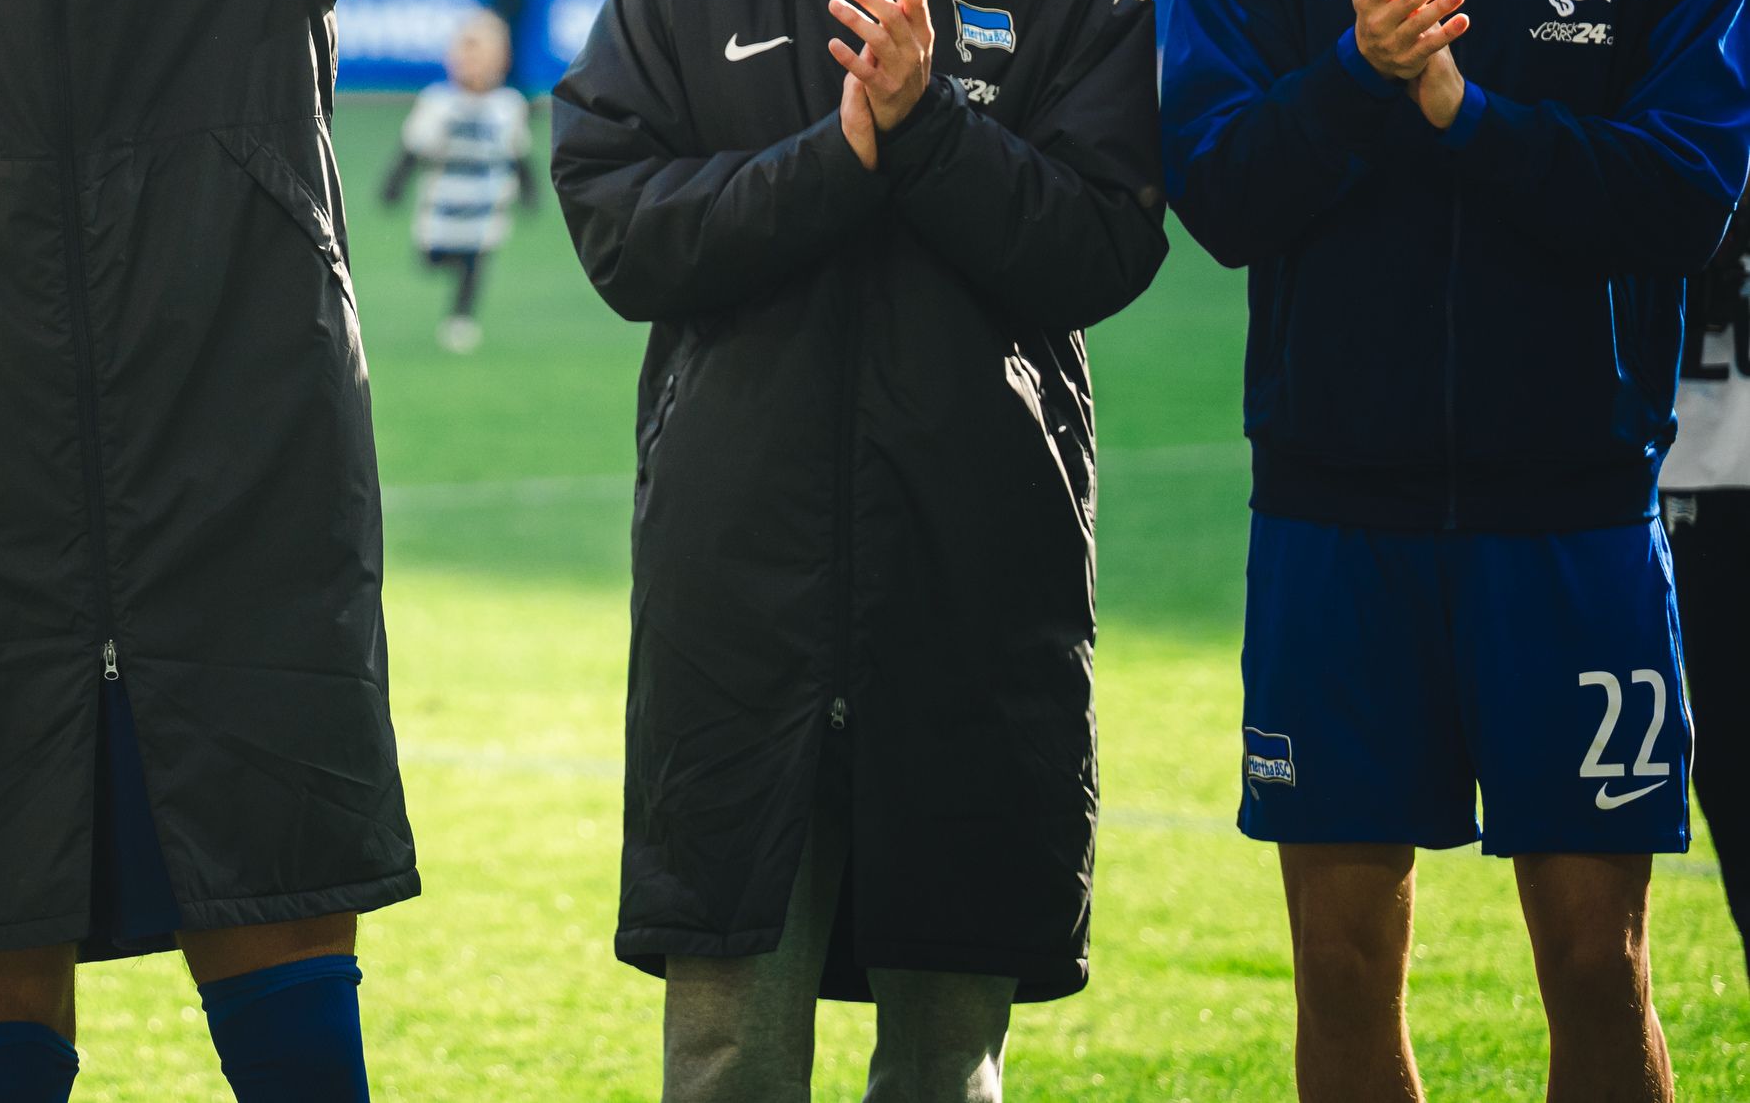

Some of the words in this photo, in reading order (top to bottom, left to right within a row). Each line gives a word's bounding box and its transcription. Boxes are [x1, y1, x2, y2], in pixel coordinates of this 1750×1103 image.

[1540, 28, 1573, 42] CARS
[1546, 20, 1579, 33] check
[1572, 22, 1607, 44] 24
[1578, 668, 1670, 778] 22
[1273, 761, 1291, 778] BSC
